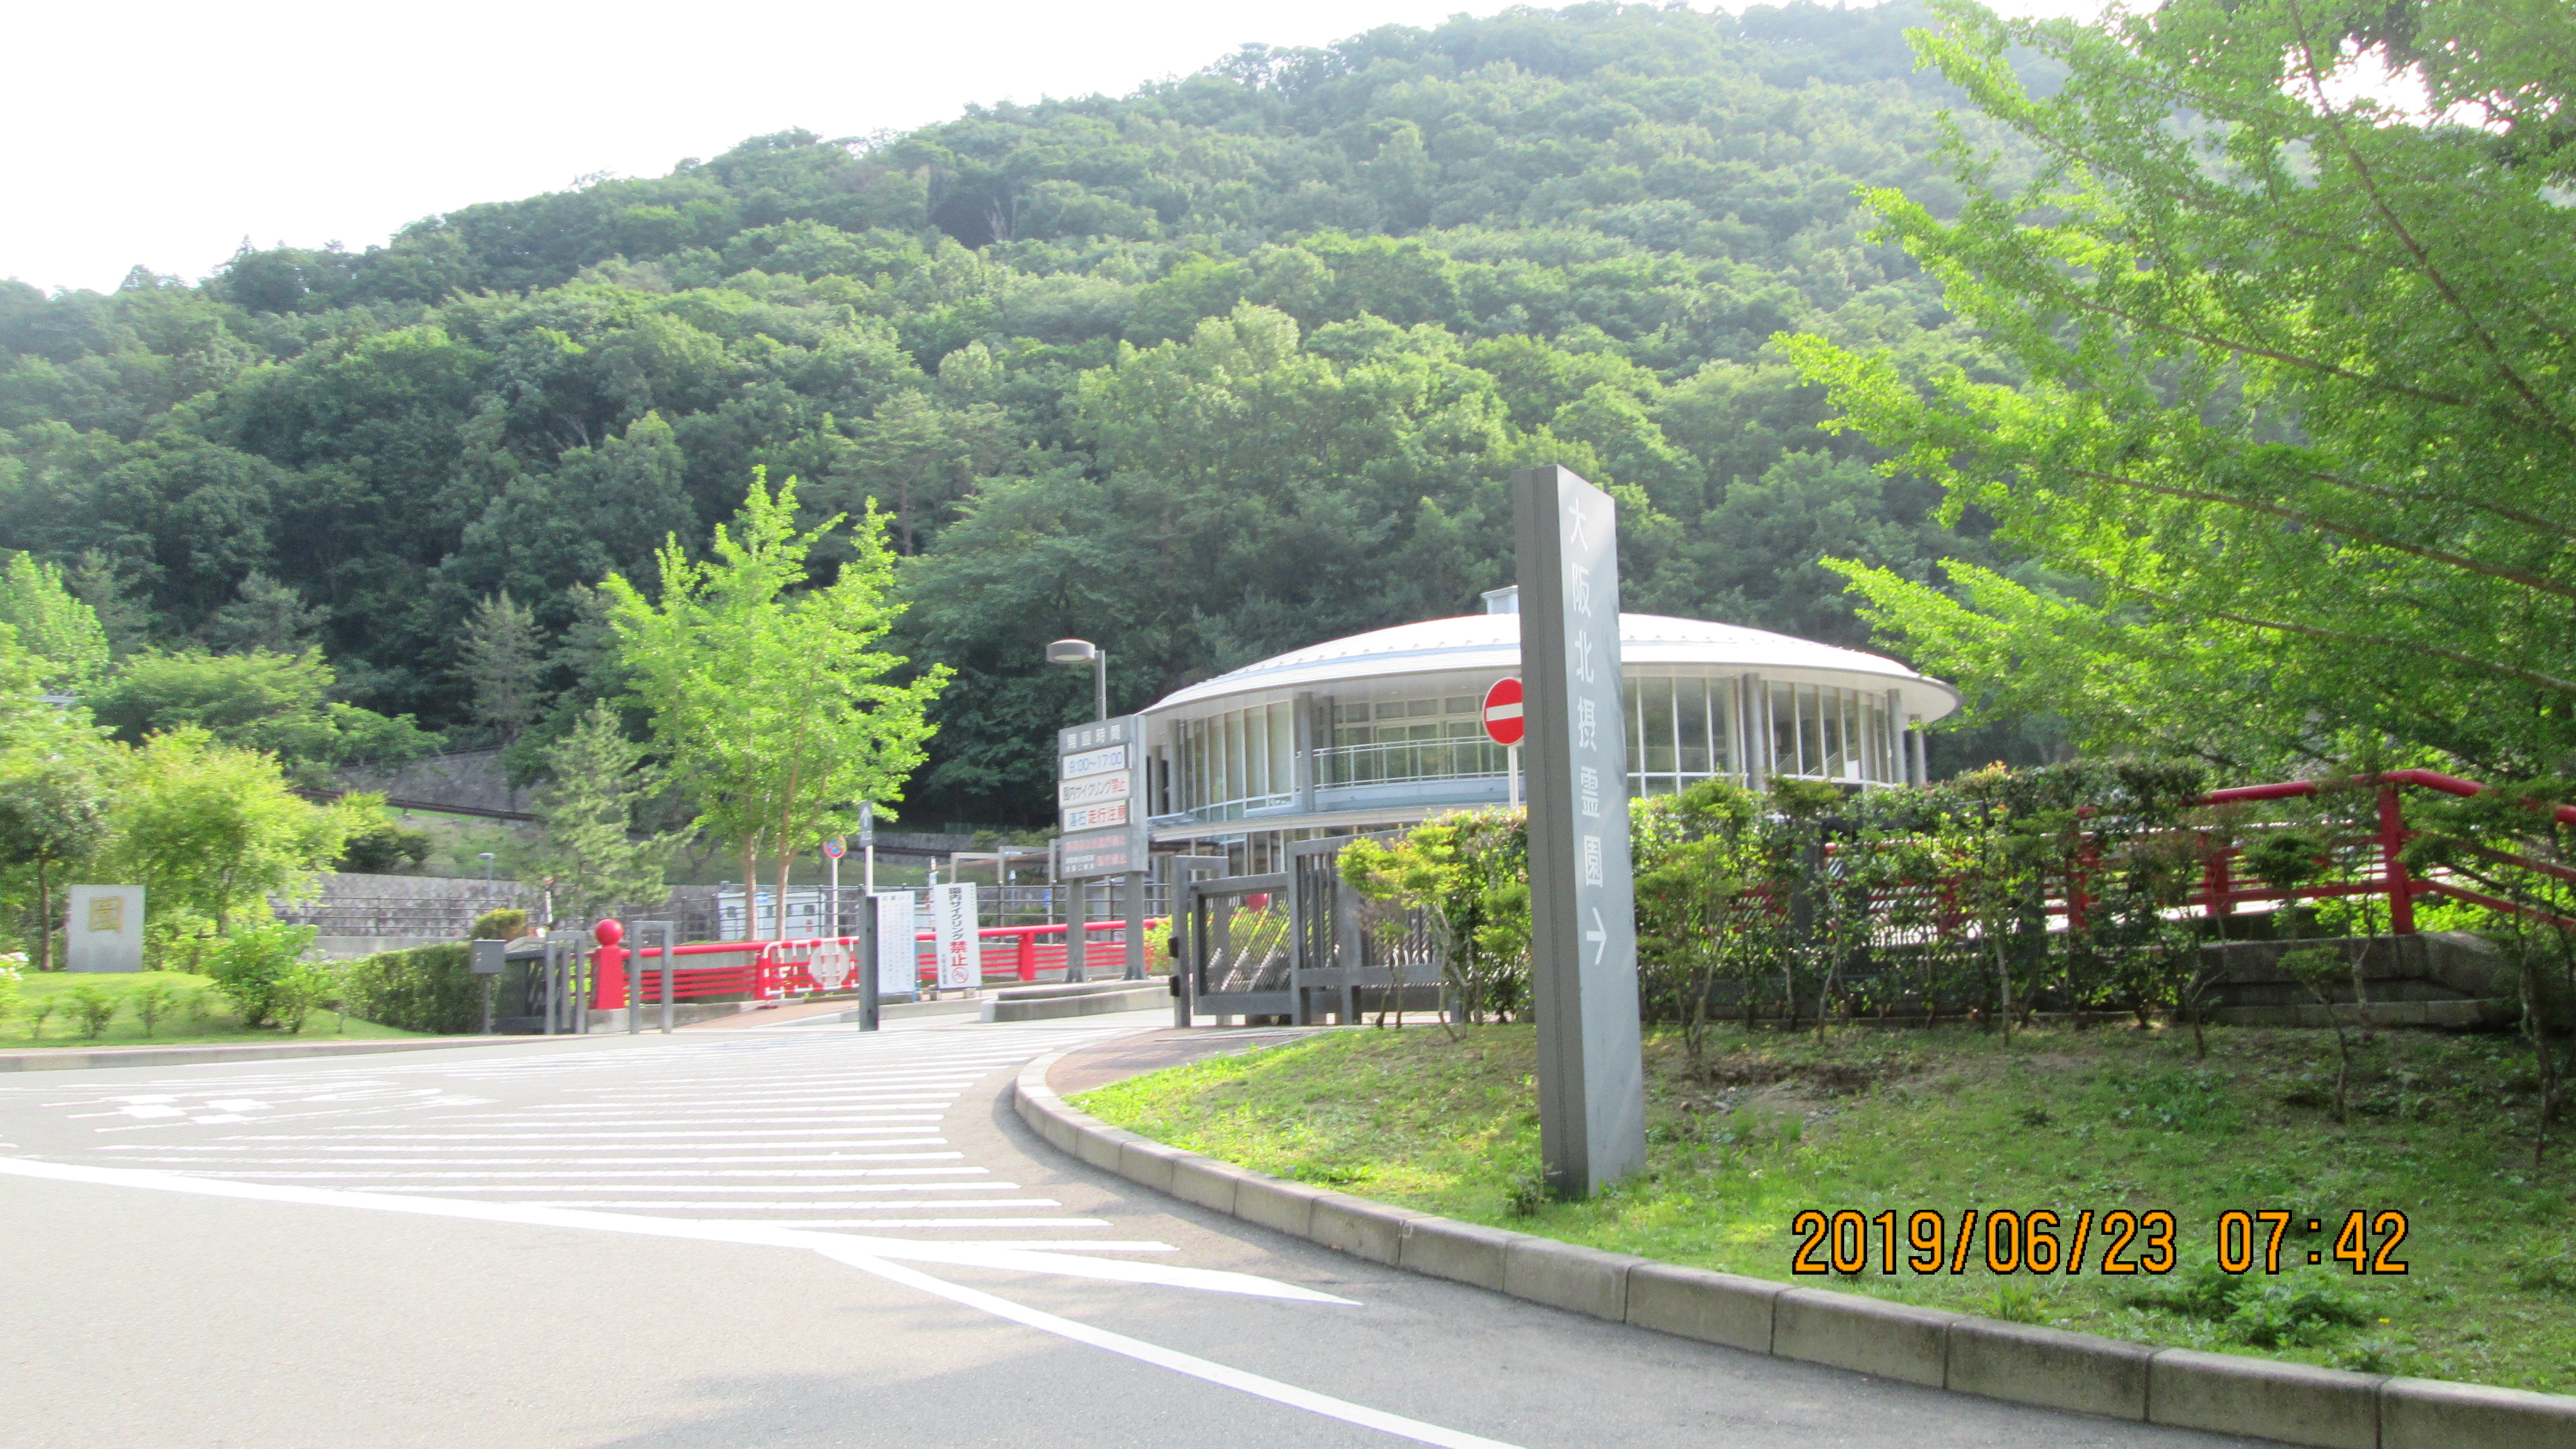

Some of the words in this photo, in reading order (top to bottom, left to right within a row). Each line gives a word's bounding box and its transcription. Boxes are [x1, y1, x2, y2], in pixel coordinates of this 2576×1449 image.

[1568, 498, 1604, 888] 大阪北摂霊園
